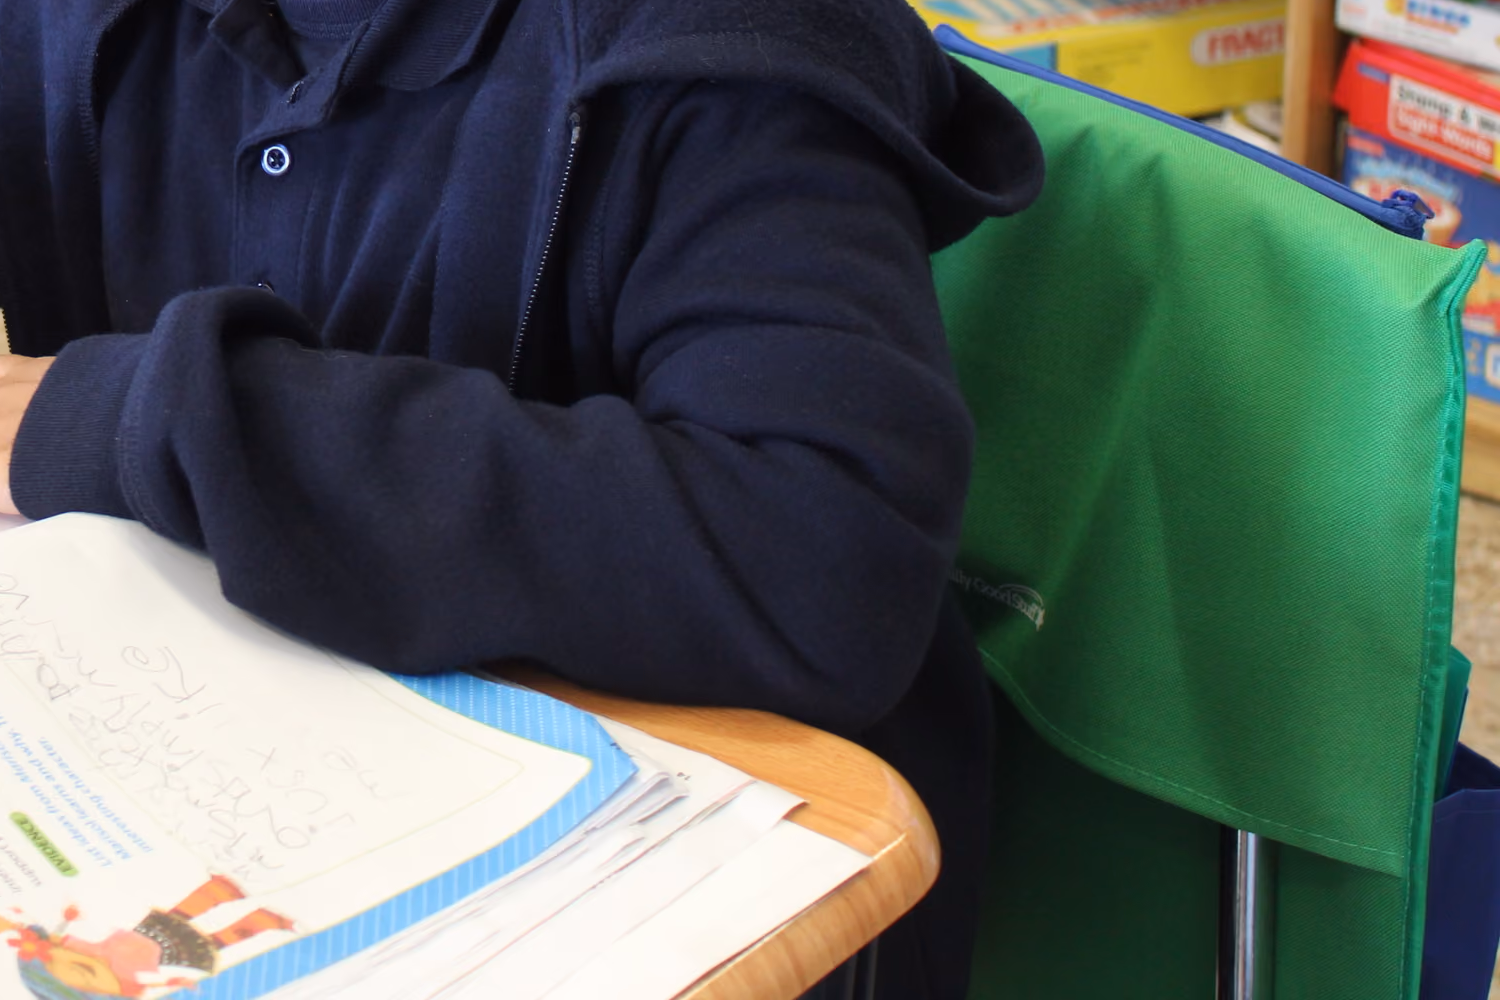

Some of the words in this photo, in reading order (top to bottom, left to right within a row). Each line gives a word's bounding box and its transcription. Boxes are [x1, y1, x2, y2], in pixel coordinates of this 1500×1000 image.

[28, 759, 55, 781] and
[30, 785, 59, 813] from
[53, 784, 89, 819] learns
[58, 816, 89, 845] ideas
[89, 795, 153, 852] interesting
[15, 816, 73, 873] EVIDENCE
[85, 821, 130, 859] Marisol
[87, 847, 112, 866] List
